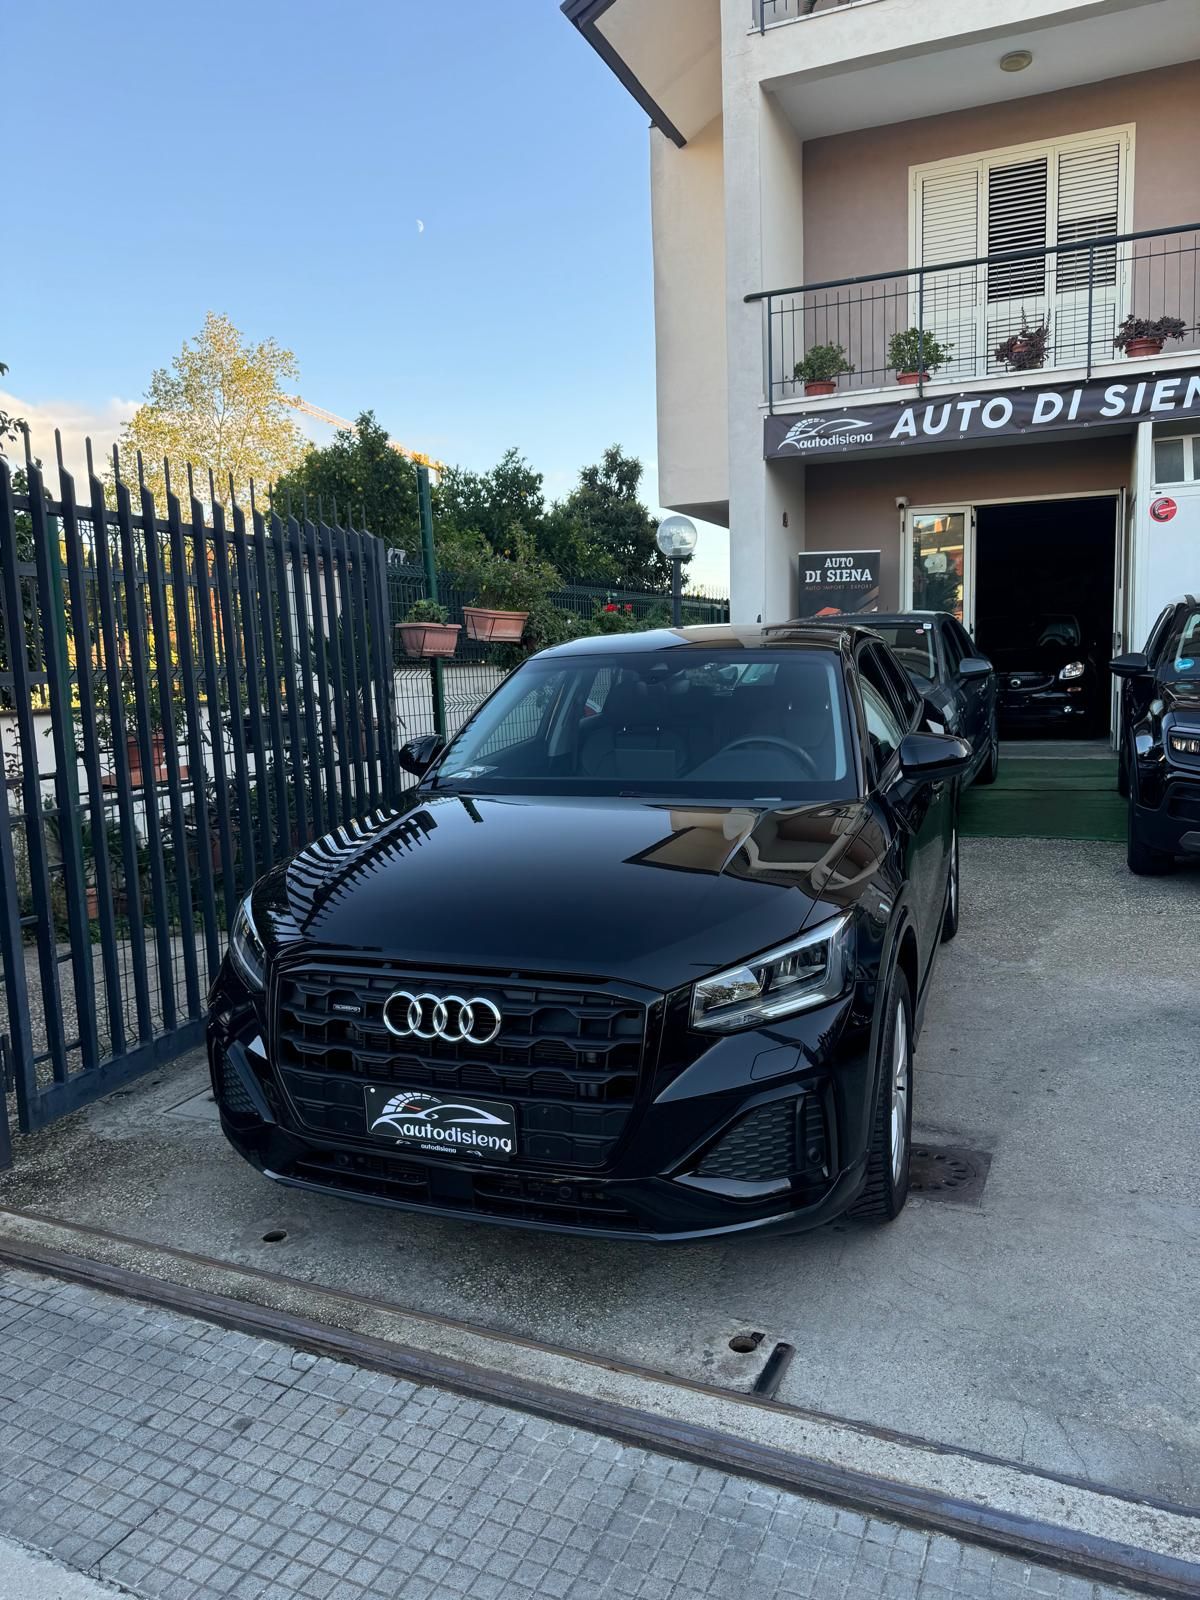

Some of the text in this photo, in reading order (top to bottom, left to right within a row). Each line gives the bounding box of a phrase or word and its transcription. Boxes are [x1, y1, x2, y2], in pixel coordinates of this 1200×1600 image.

[890, 397, 1013, 439] AUTO
[1031, 389, 1083, 424] DI
[800, 433, 873, 449] autodisiena
[824, 557, 854, 568] AUTO
[805, 568, 873, 583] DI SIENA
[403, 1123, 512, 1153] autodisiena
[421, 1144, 457, 1154] autodisiena
